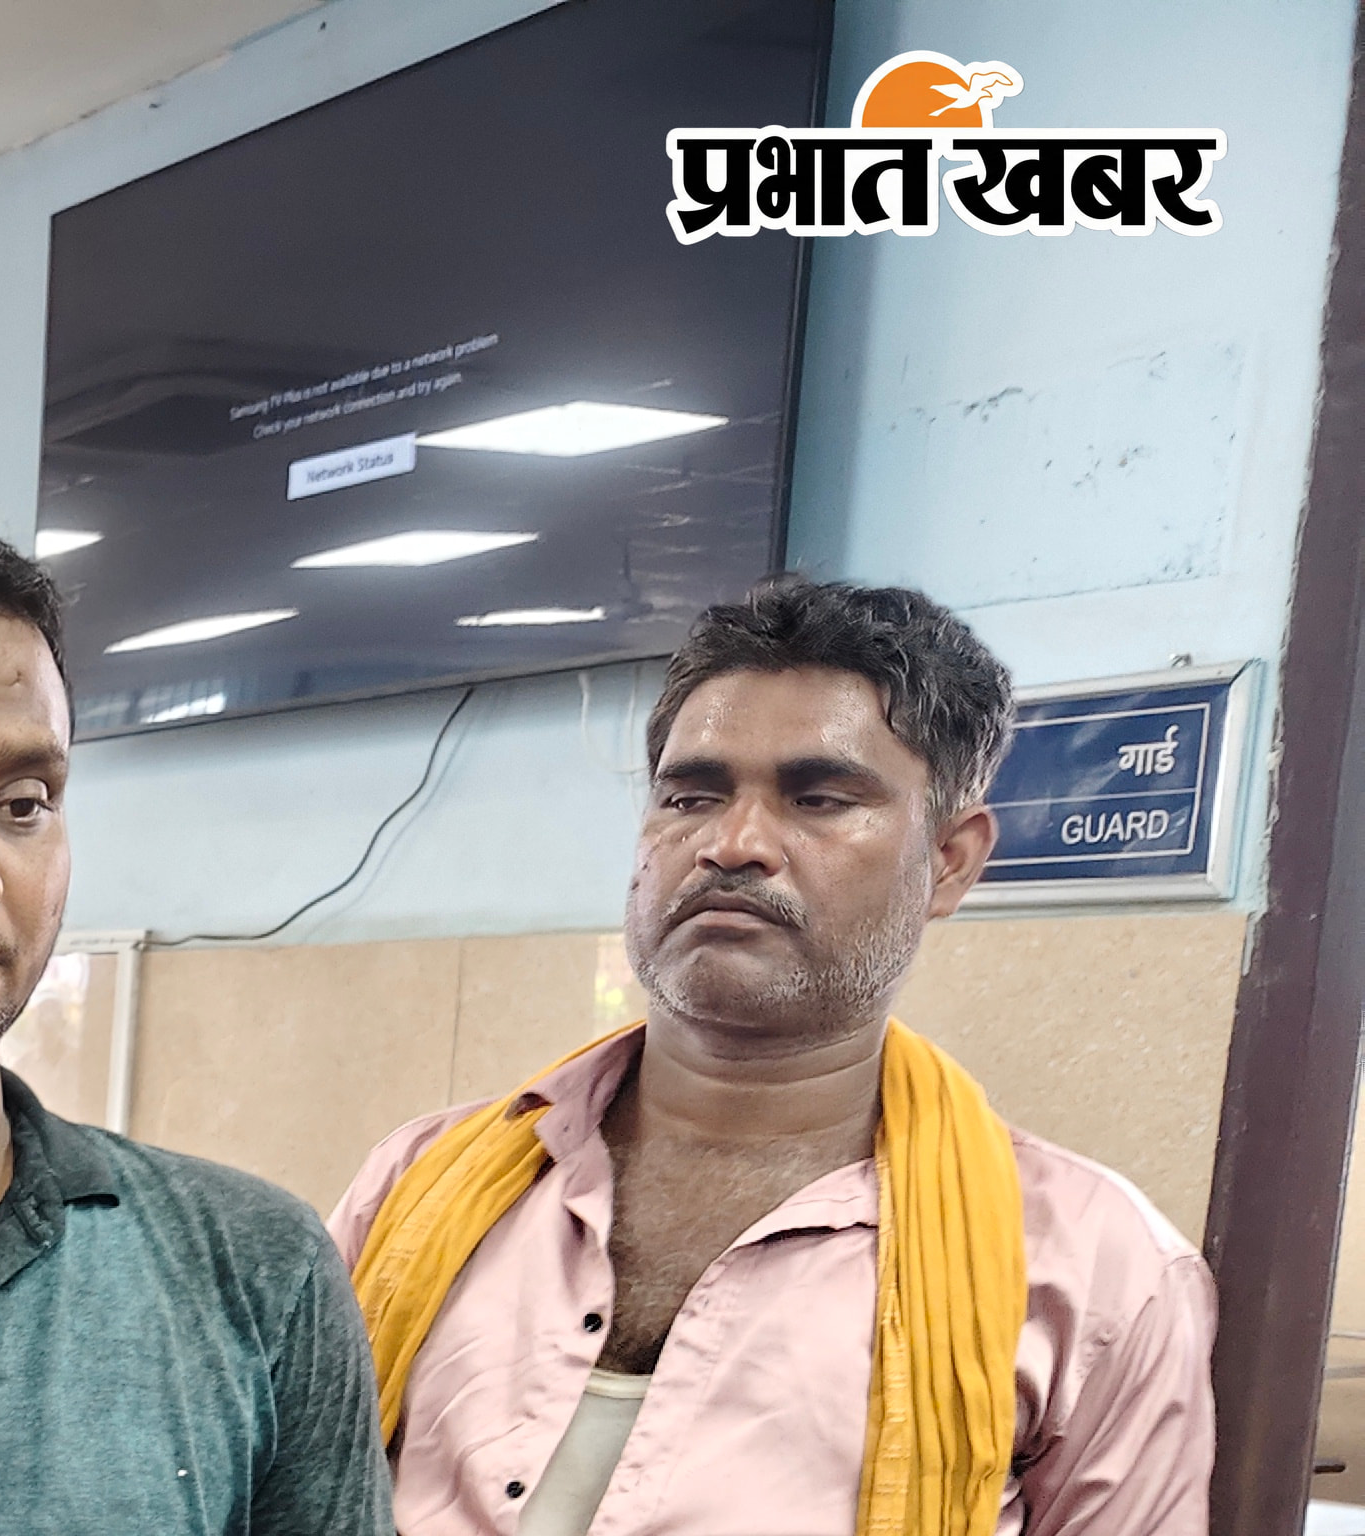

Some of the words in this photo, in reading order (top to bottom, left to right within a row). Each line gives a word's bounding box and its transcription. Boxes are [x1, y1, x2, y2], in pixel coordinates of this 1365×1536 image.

[307, 462, 354, 482] Network
[356, 454, 394, 473] Status
[1118, 724, 1179, 777] गार्ड
[1061, 810, 1170, 845] GUARD
